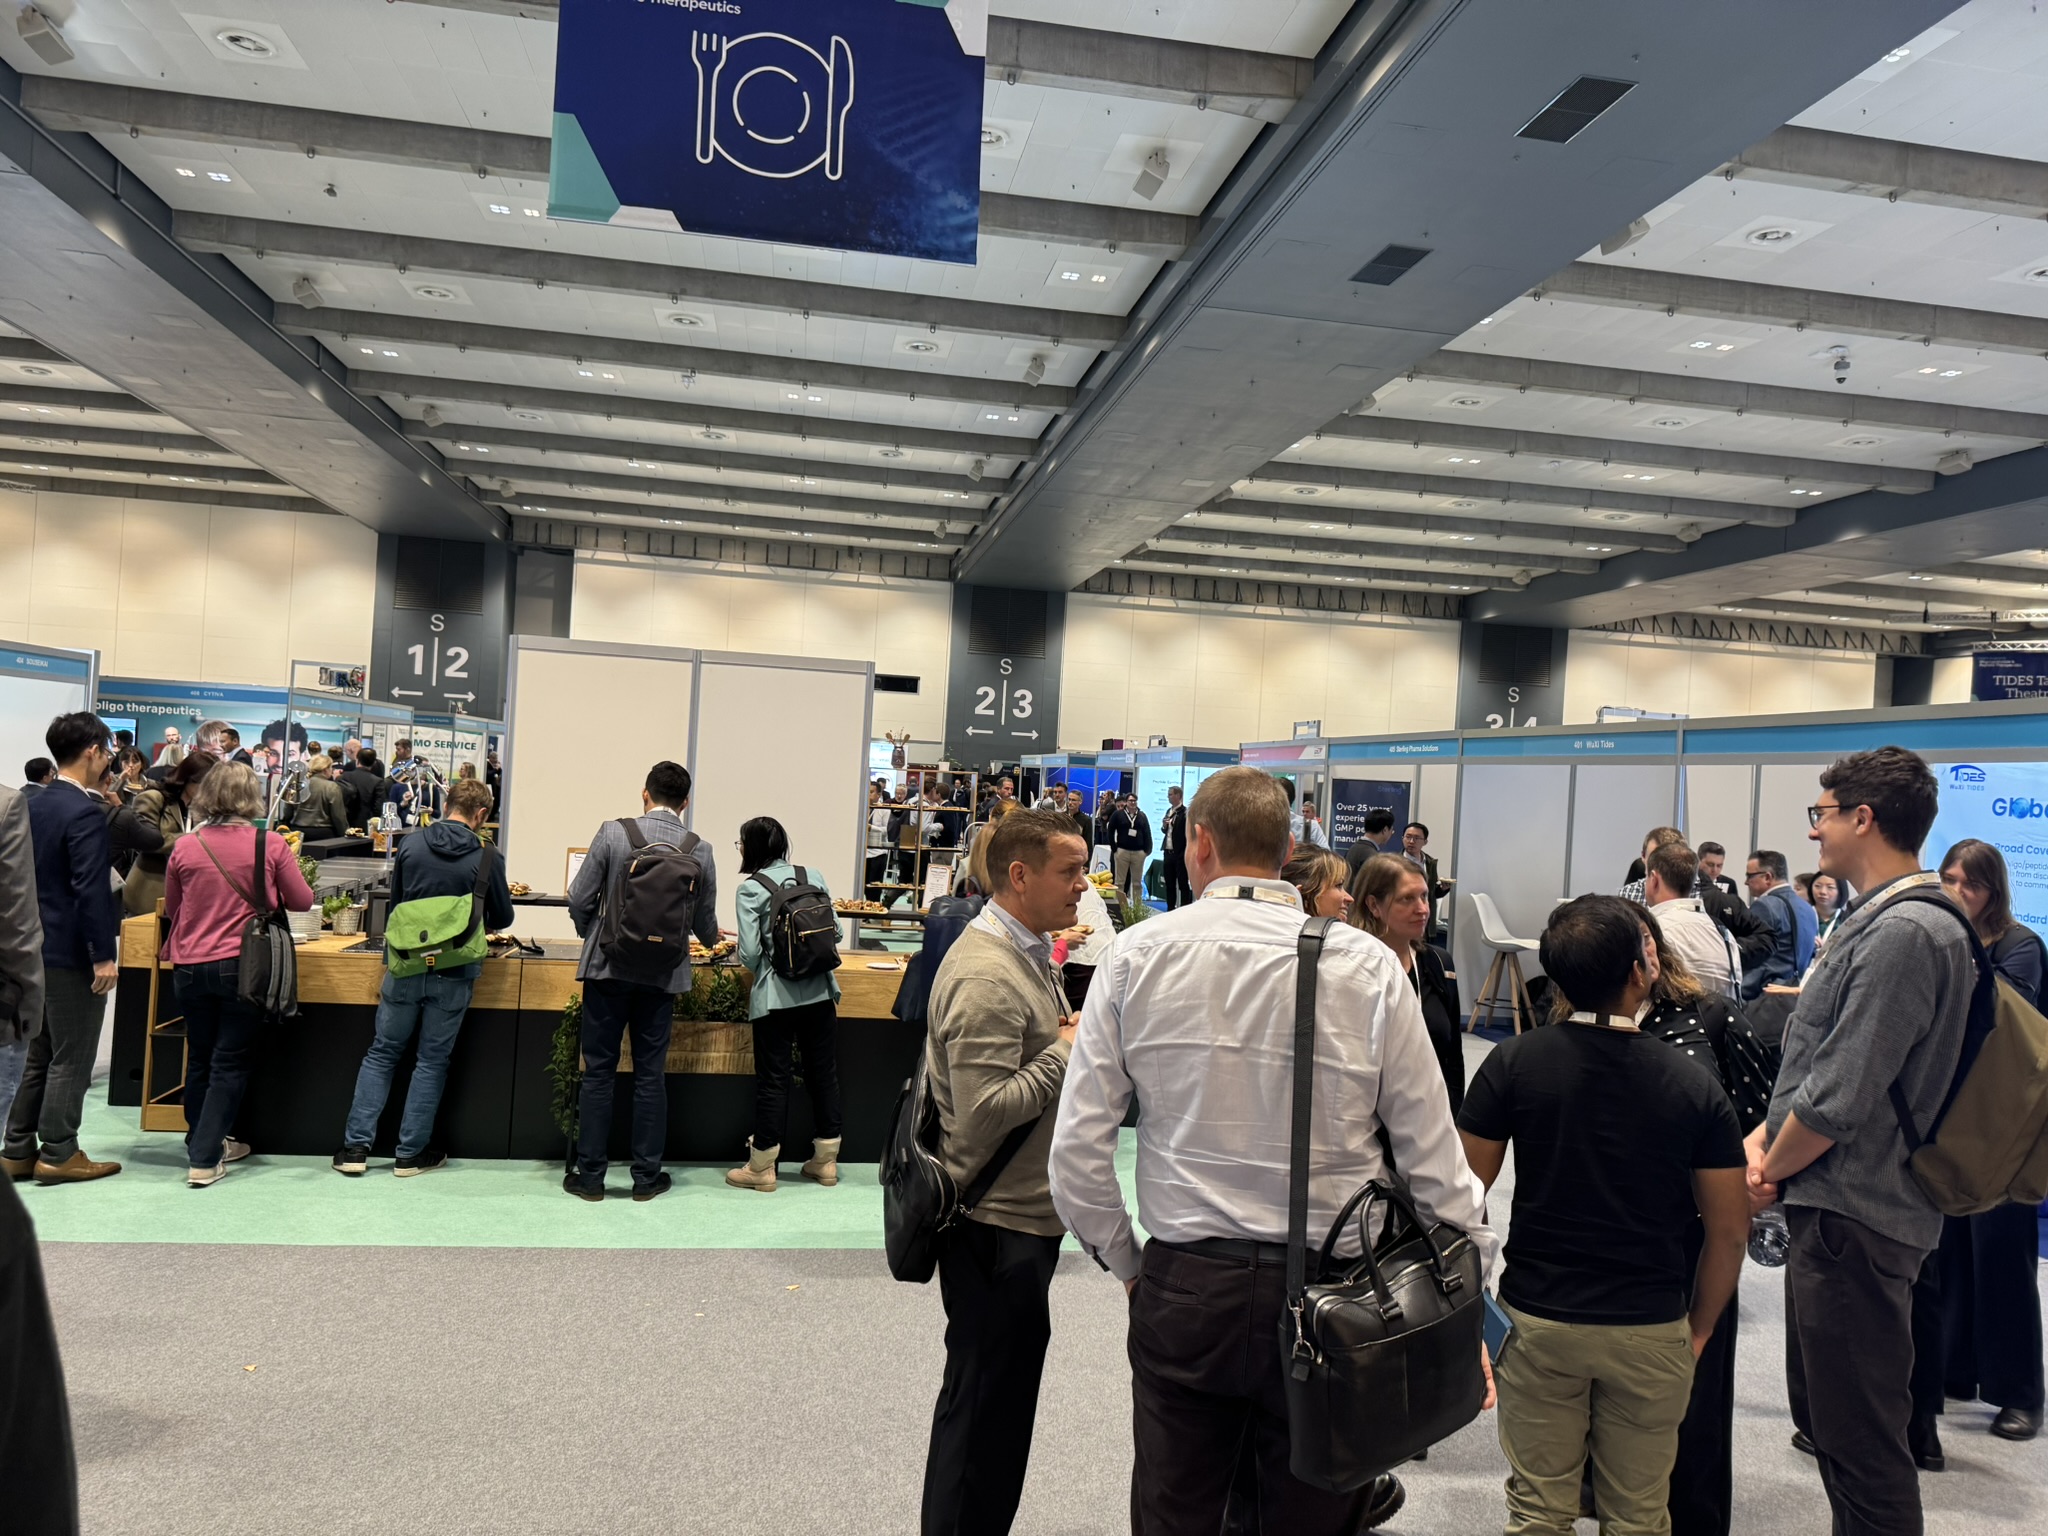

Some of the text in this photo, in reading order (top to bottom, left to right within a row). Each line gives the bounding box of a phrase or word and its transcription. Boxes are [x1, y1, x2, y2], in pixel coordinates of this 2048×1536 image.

[650, 0, 741, 15] erapeutics
[430, 613, 445, 632] S
[407, 644, 469, 678] 1 2
[1000, 658, 1013, 675] S
[1993, 675, 2034, 686] TIDES
[974, 686, 1033, 718] 2 3
[1508, 686, 1519, 703] S
[96, 701, 202, 716] oligo therapeutics
[434, 740, 477, 750] SERVICE
[1600, 740, 1615, 749] Tides
[1336, 803, 1356, 811] Over
[1357, 803, 1368, 812] 25
[1334, 824, 1354, 832] GMP
